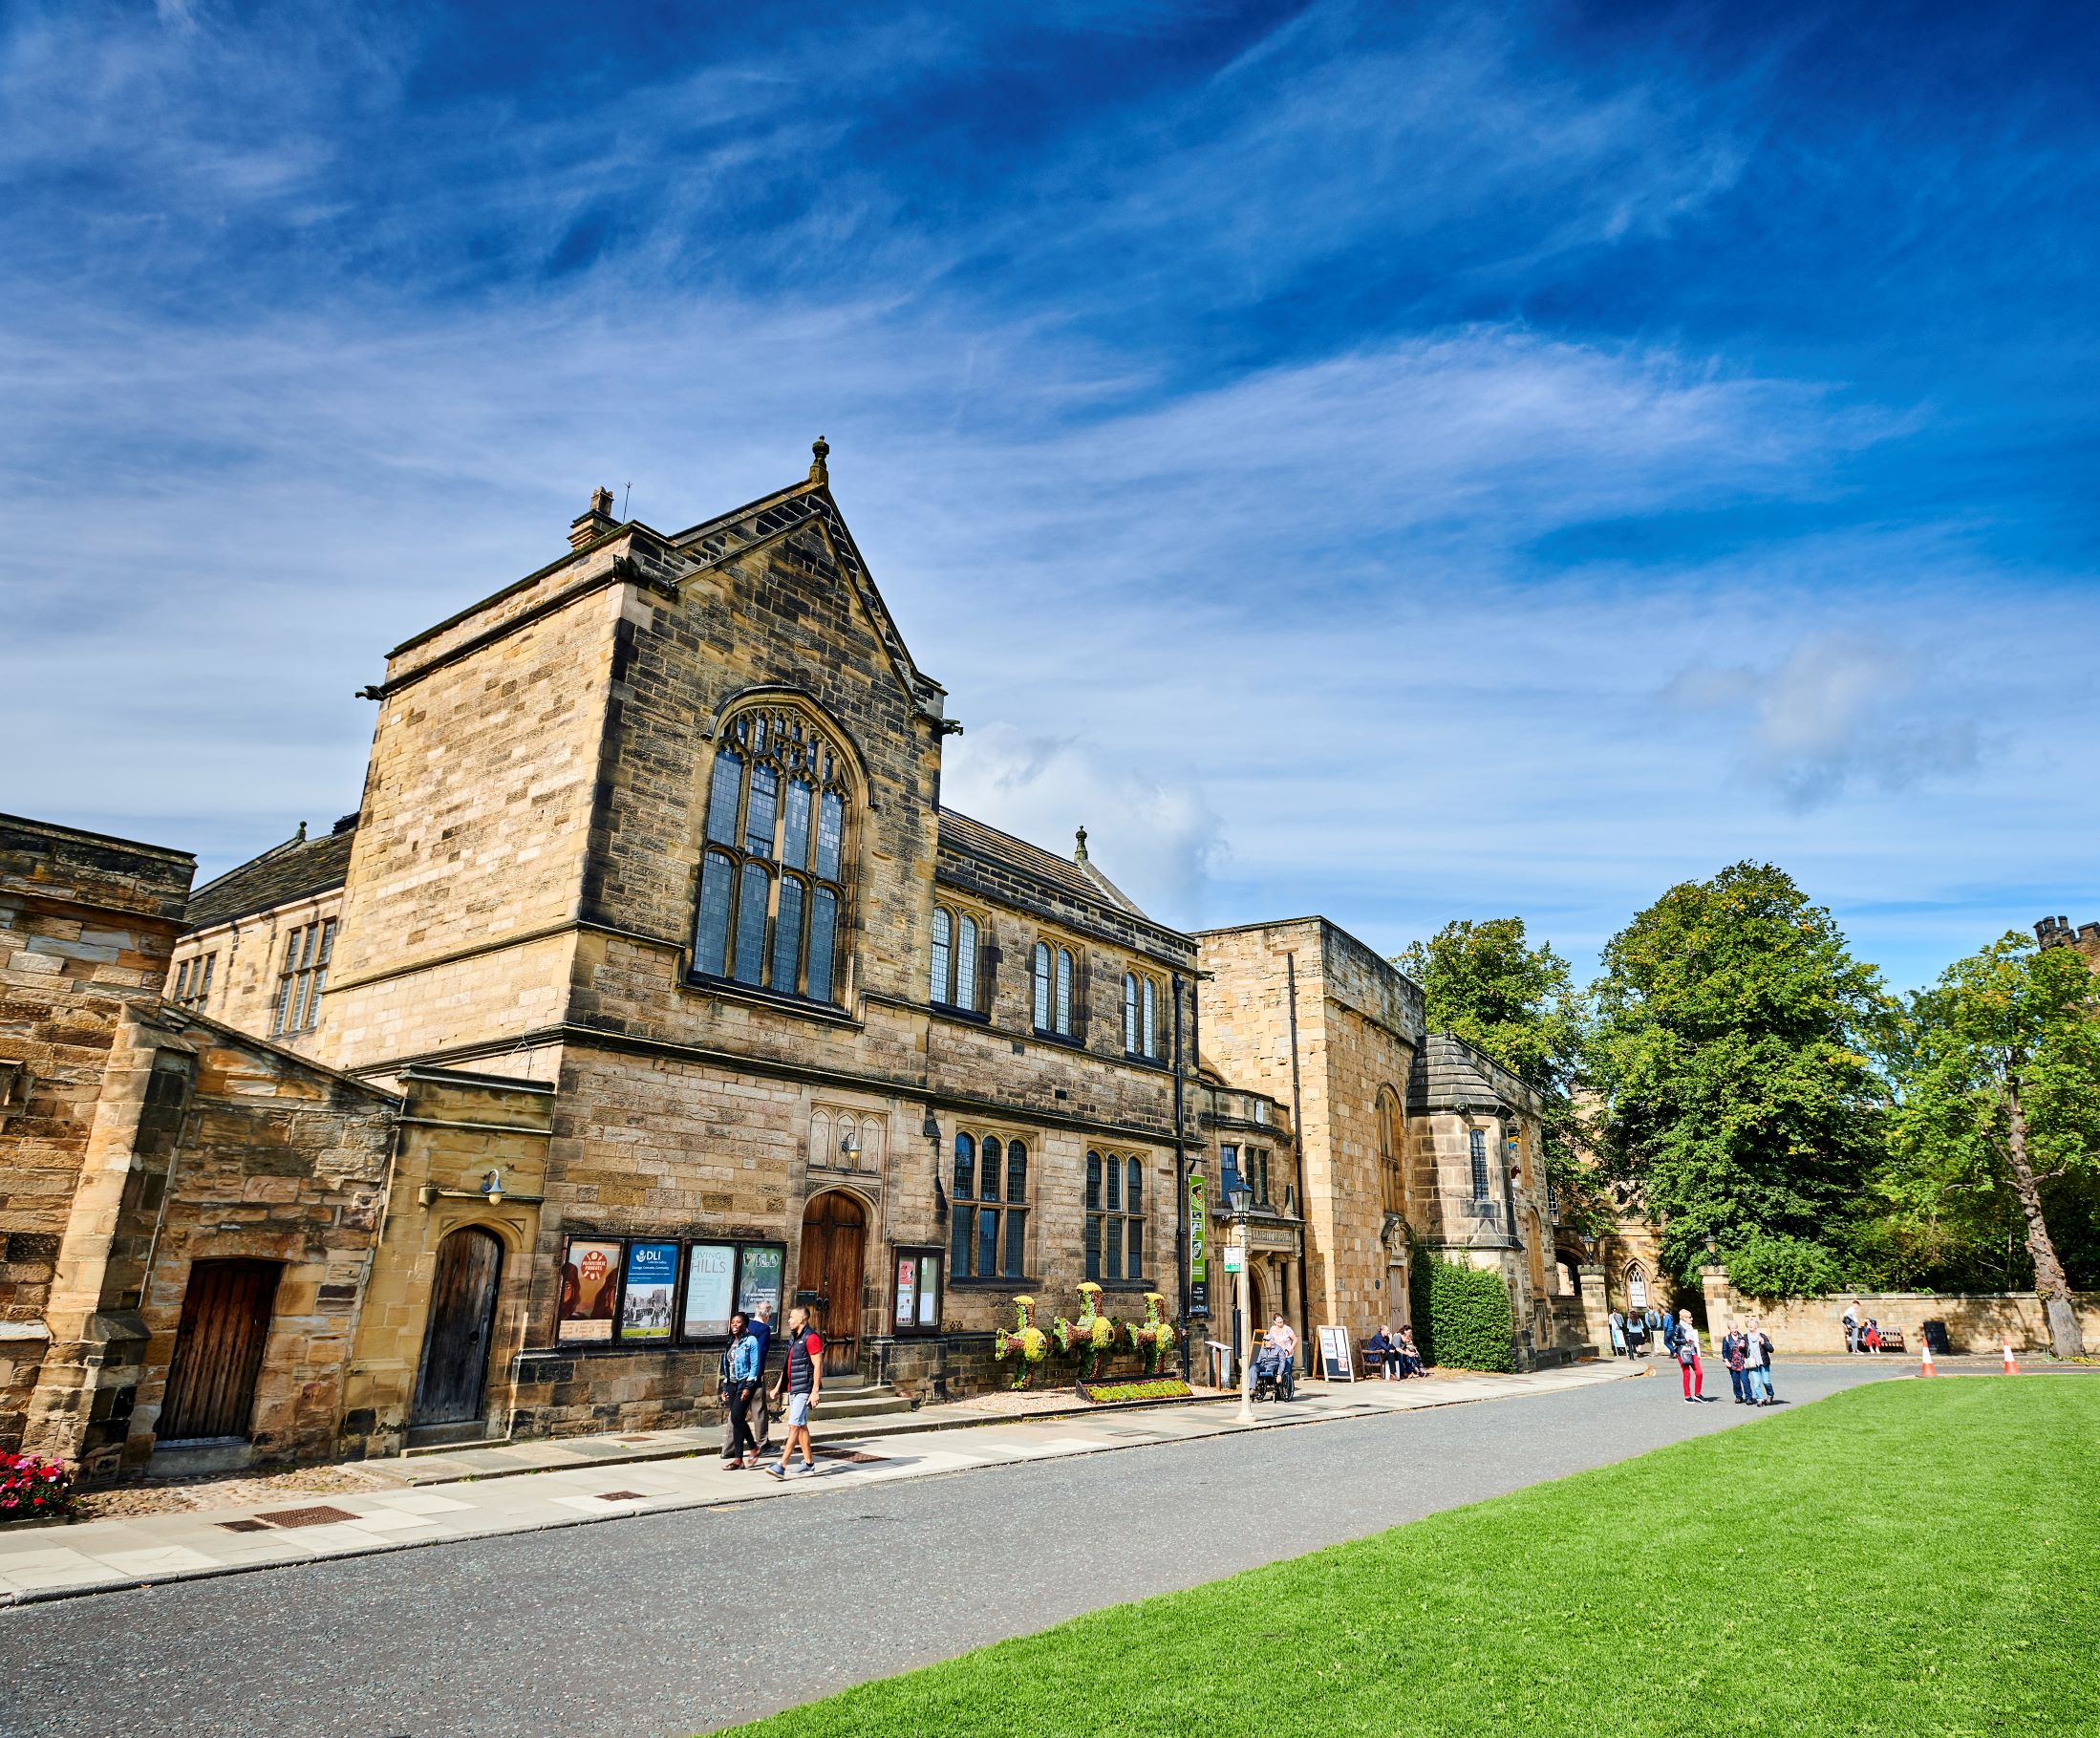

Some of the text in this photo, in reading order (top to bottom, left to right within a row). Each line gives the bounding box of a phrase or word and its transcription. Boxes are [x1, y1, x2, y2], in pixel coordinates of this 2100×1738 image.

[647, 1251, 661, 1260] DLI
[692, 1252, 721, 1260] LIVING
[743, 1253, 779, 1267] WILD
[691, 1259, 726, 1274] HILLS
